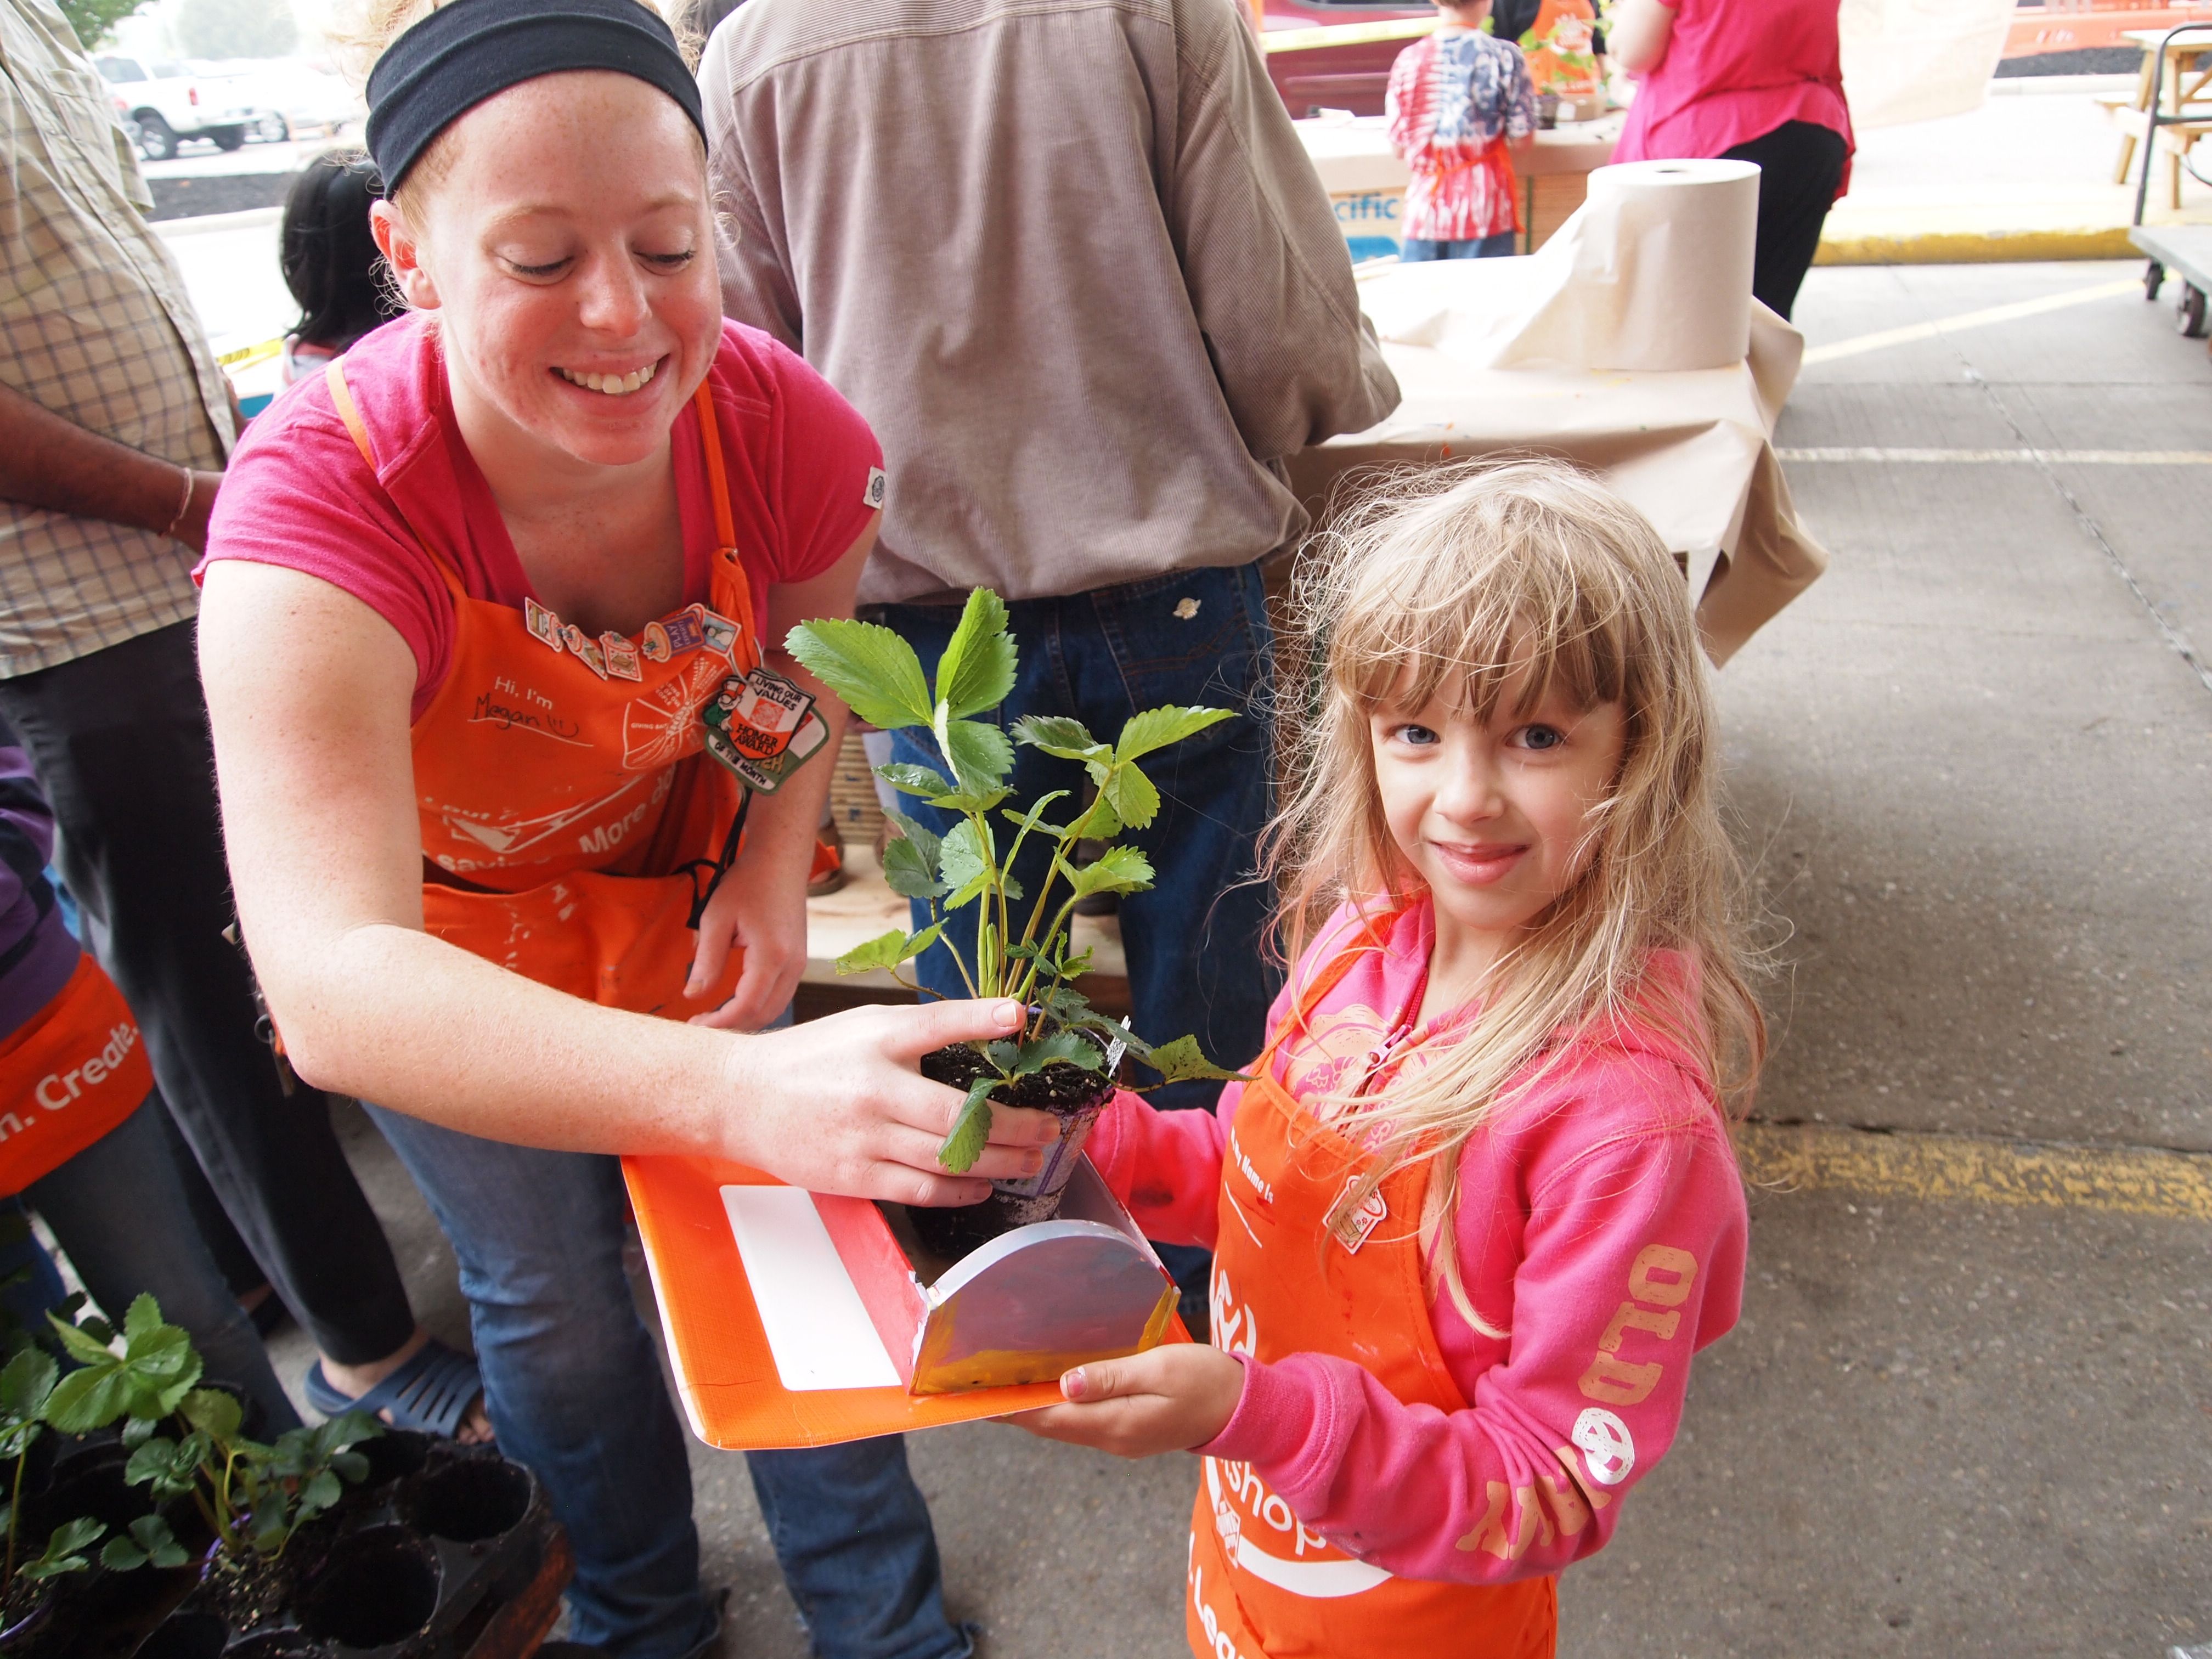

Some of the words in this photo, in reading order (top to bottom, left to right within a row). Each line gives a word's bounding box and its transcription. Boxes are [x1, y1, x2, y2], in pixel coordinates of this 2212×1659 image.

[667, 625, 683, 647] PLAY
[527, 689, 552, 710] I'm
[753, 687, 797, 711] VALUES
[755, 677, 783, 693] LIVING
[785, 690, 802, 703] OUR
[473, 693, 540, 730] Megan
[735, 735, 774, 755] AWARD
[737, 723, 778, 747] HOMER
[714, 741, 724, 752] OF
[725, 749, 740, 765] THE
[738, 760, 767, 785] MONTH
[578, 803, 647, 853] More
[35, 1022, 138, 1111] Create.
[1242, 1155, 1264, 1193] Name
[1577, 1244, 1698, 1406] OLD
[1224, 1455, 1327, 1556] shop
[1194, 1565, 1248, 1659] Lea
